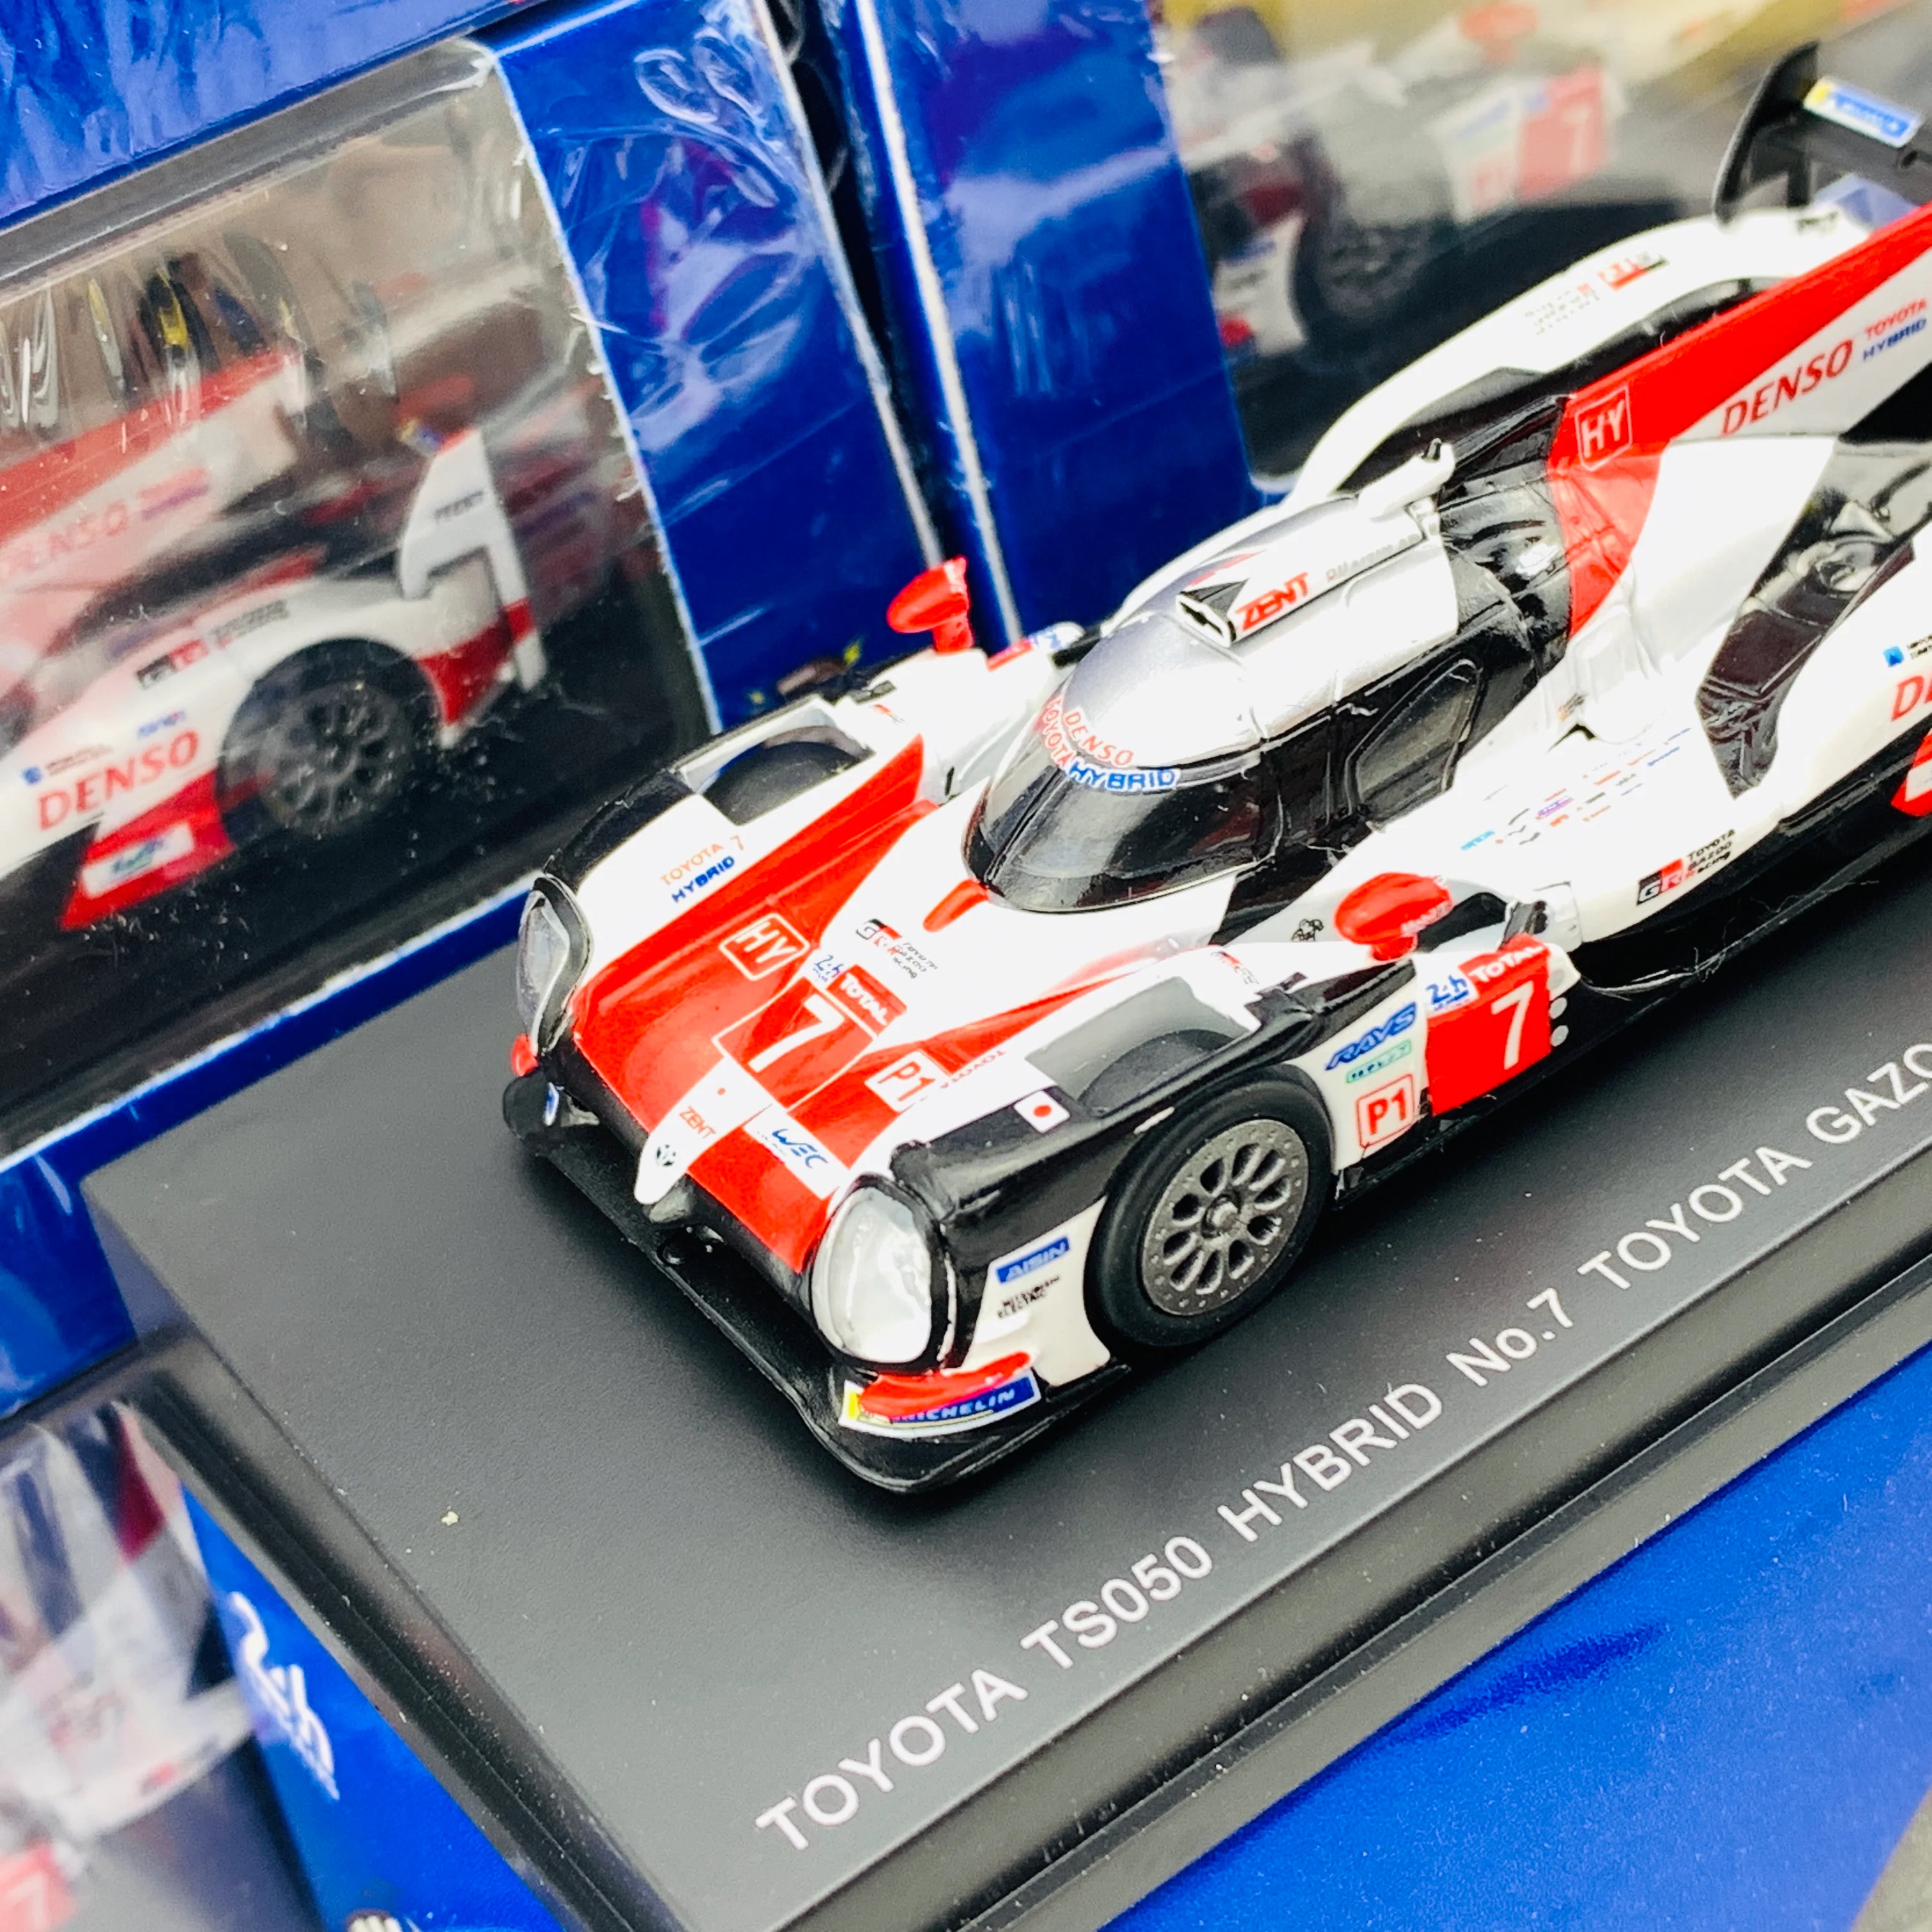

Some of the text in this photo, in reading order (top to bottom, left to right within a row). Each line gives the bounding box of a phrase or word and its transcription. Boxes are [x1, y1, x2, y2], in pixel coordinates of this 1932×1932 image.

[1863, 318, 1927, 362] HYBRID
[1864, 298, 1928, 340] TOYOTA
[1721, 339, 1853, 437] DENSO
[1581, 399, 1625, 458] HY
[1235, 571, 1308, 631] ZENT
[1043, 698, 1075, 767] TOYOTA
[1064, 710, 1135, 767] DENSO
[39, 730, 199, 830] DENSO
[1070, 760, 1176, 789] HYBRID
[660, 843, 724, 885] TOYOTA
[1687, 829, 1735, 860] TOYOTA
[671, 855, 735, 903] HYBRID
[735, 921, 797, 963] HY
[1469, 946, 1547, 982] TOTAL
[841, 972, 887, 1025] TOTAL
[748, 993, 845, 1073] 7
[1325, 1002, 1416, 1071] RAYS
[1491, 980, 1534, 1071] 7
[878, 1061, 935, 1101] P1
[679, 1105, 716, 1138] ZENT
[1367, 1088, 1406, 1136] P1
[772, 1128, 828, 1169] WEC
[1006, 1241, 1067, 1281] AISIN
[756, 1669, 1027, 1850] TOYOTA
[1021, 1537, 1213, 1669] TS050
[1217, 1383, 1443, 1542] HYBRID
[1446, 1287, 1574, 1386] No.7
[1577, 1146, 1813, 1289] TOYOTA
